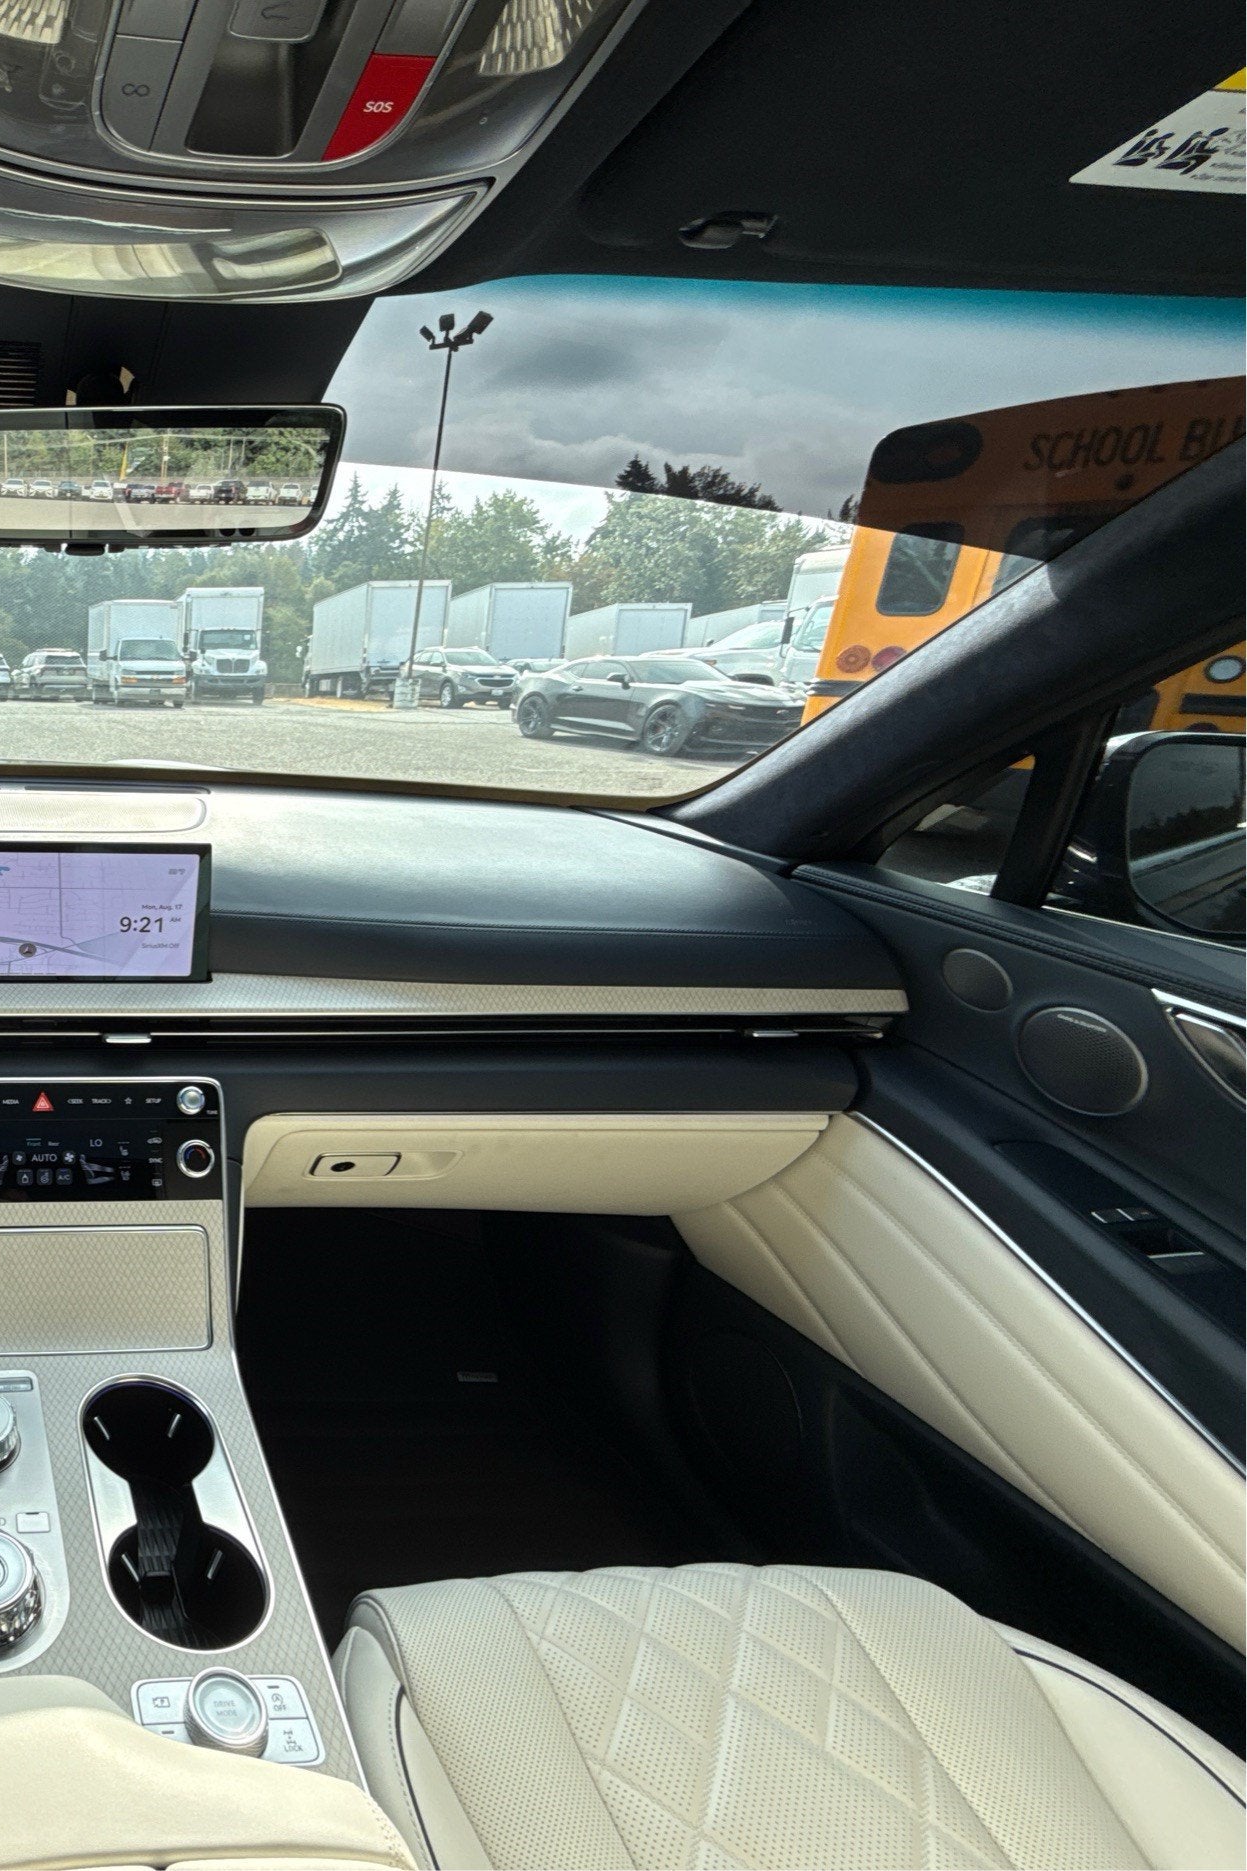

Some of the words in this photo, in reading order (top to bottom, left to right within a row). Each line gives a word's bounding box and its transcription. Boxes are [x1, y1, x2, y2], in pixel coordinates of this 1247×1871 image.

[363, 101, 394, 113] SOS
[1022, 422, 1163, 470] SCHOOL
[119, 916, 164, 933] 9:21
[89, 1138, 103, 1148] LO
[32, 1153, 58, 1162] AUTO
[213, 1700, 236, 1708] DRIVE
[273, 1704, 287, 1712] OFF
[216, 1709, 237, 1717] MODE
